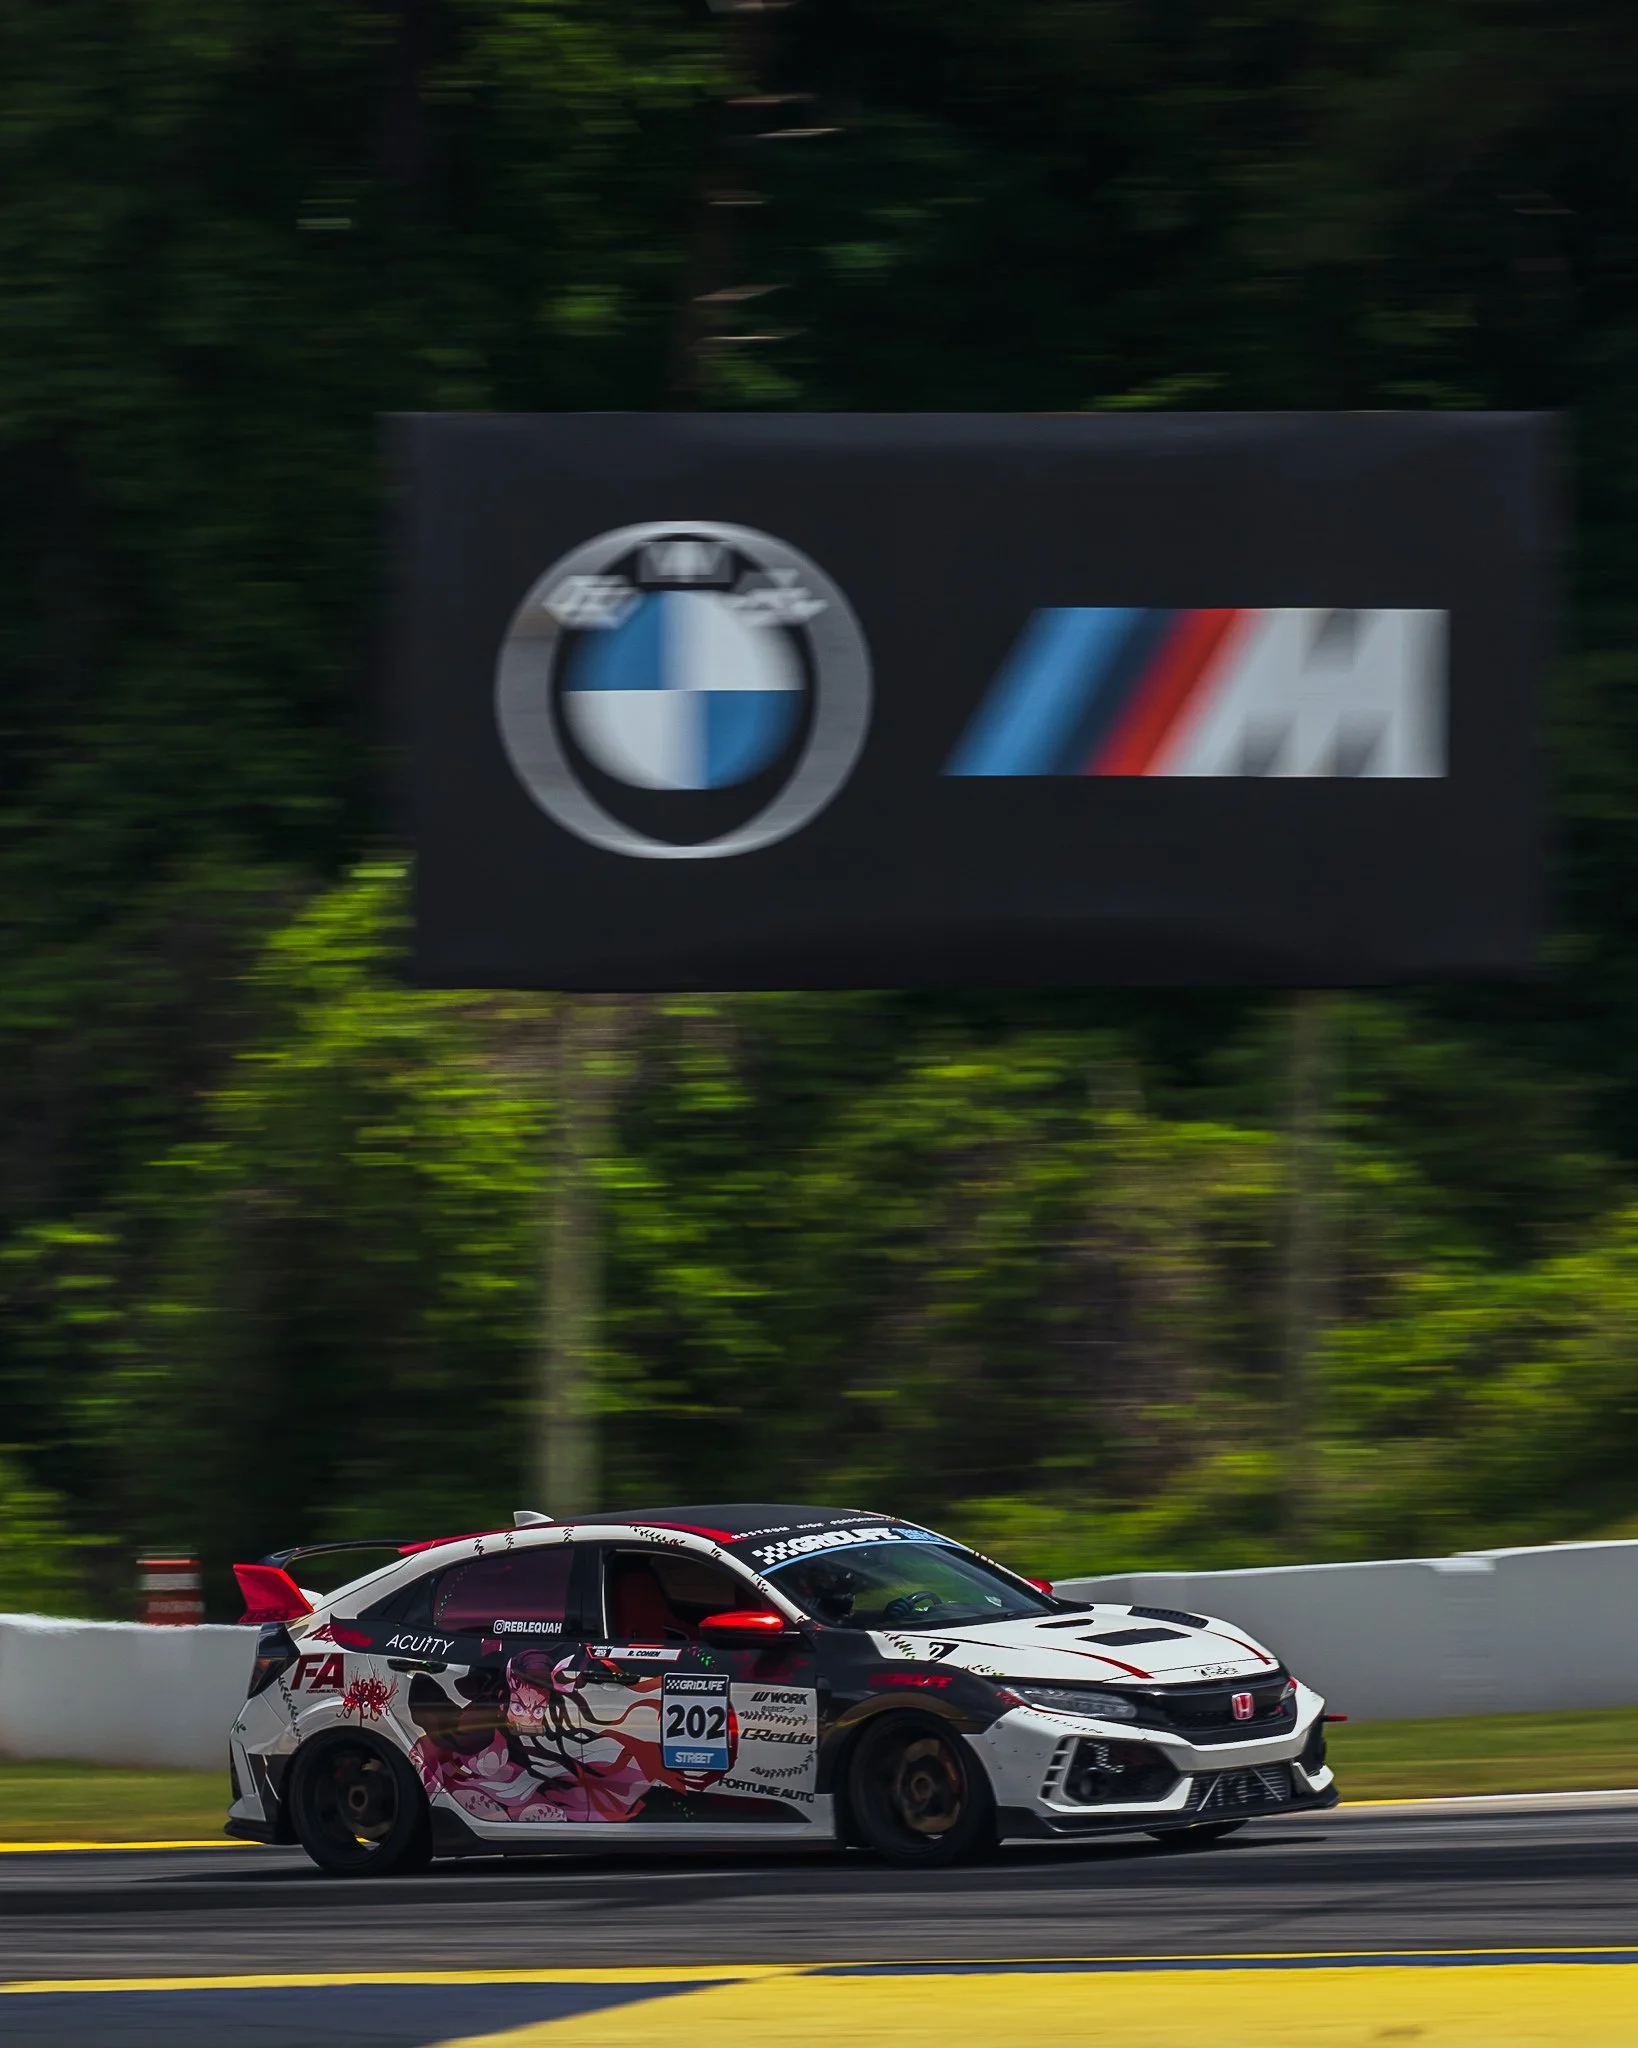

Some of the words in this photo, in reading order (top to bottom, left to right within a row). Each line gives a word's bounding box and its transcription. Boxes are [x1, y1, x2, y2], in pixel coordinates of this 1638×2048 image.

[787, 1527, 901, 1553] GRIDLIFE
[386, 1634, 455, 1655] ACUITY
[291, 1653, 344, 1690] FA
[679, 1680, 725, 1691] GRIDLIFE
[770, 1691, 809, 1705] WORK
[666, 1704, 725, 1740] 202
[740, 1727, 816, 1745] GReddy
[675, 1751, 715, 1764] STREET
[718, 1777, 781, 1796] FORTUNE
[779, 1789, 815, 1803] AUTO
